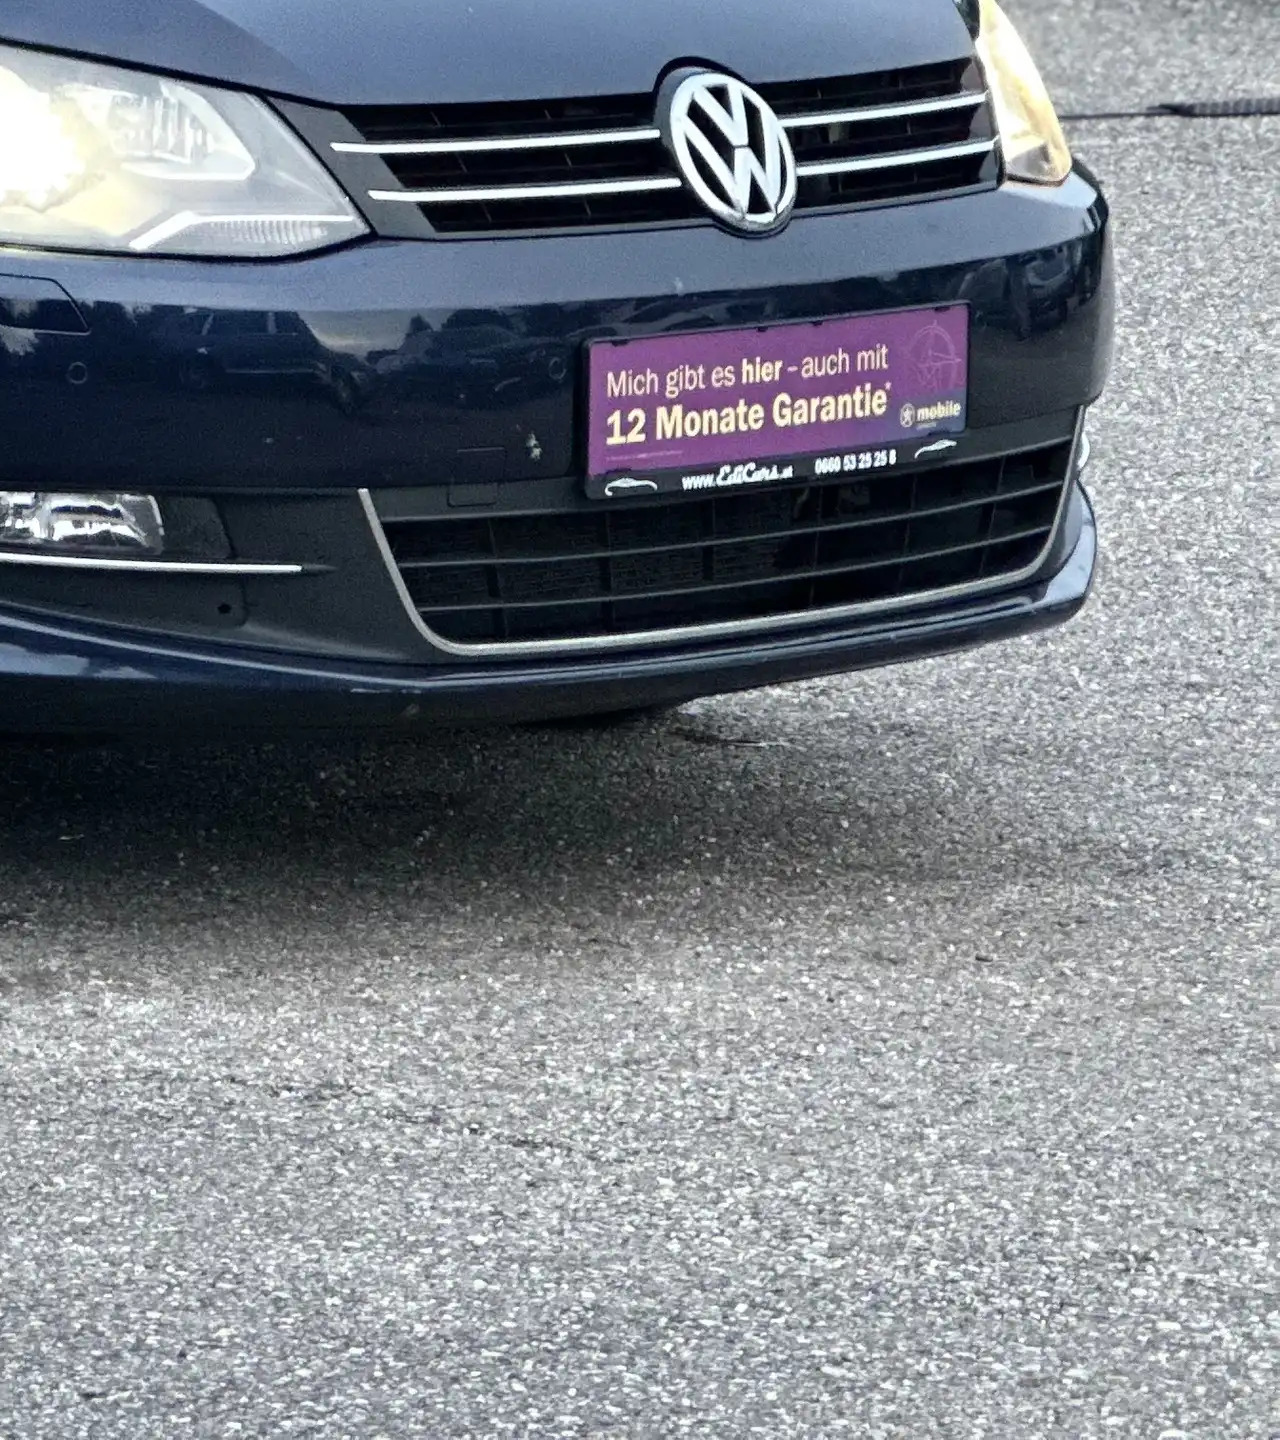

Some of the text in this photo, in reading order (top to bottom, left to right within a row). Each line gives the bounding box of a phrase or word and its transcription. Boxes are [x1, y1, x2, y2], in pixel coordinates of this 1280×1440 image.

[607, 367, 659, 398] Mich
[665, 363, 706, 399] gibt
[711, 364, 736, 389] es
[741, 356, 784, 385] hier
[801, 347, 850, 379] auch
[856, 342, 889, 372] mit
[605, 407, 647, 446] 12
[655, 398, 765, 441] Monate
[917, 400, 962, 422] mobile
[843, 453, 857, 472] 53
